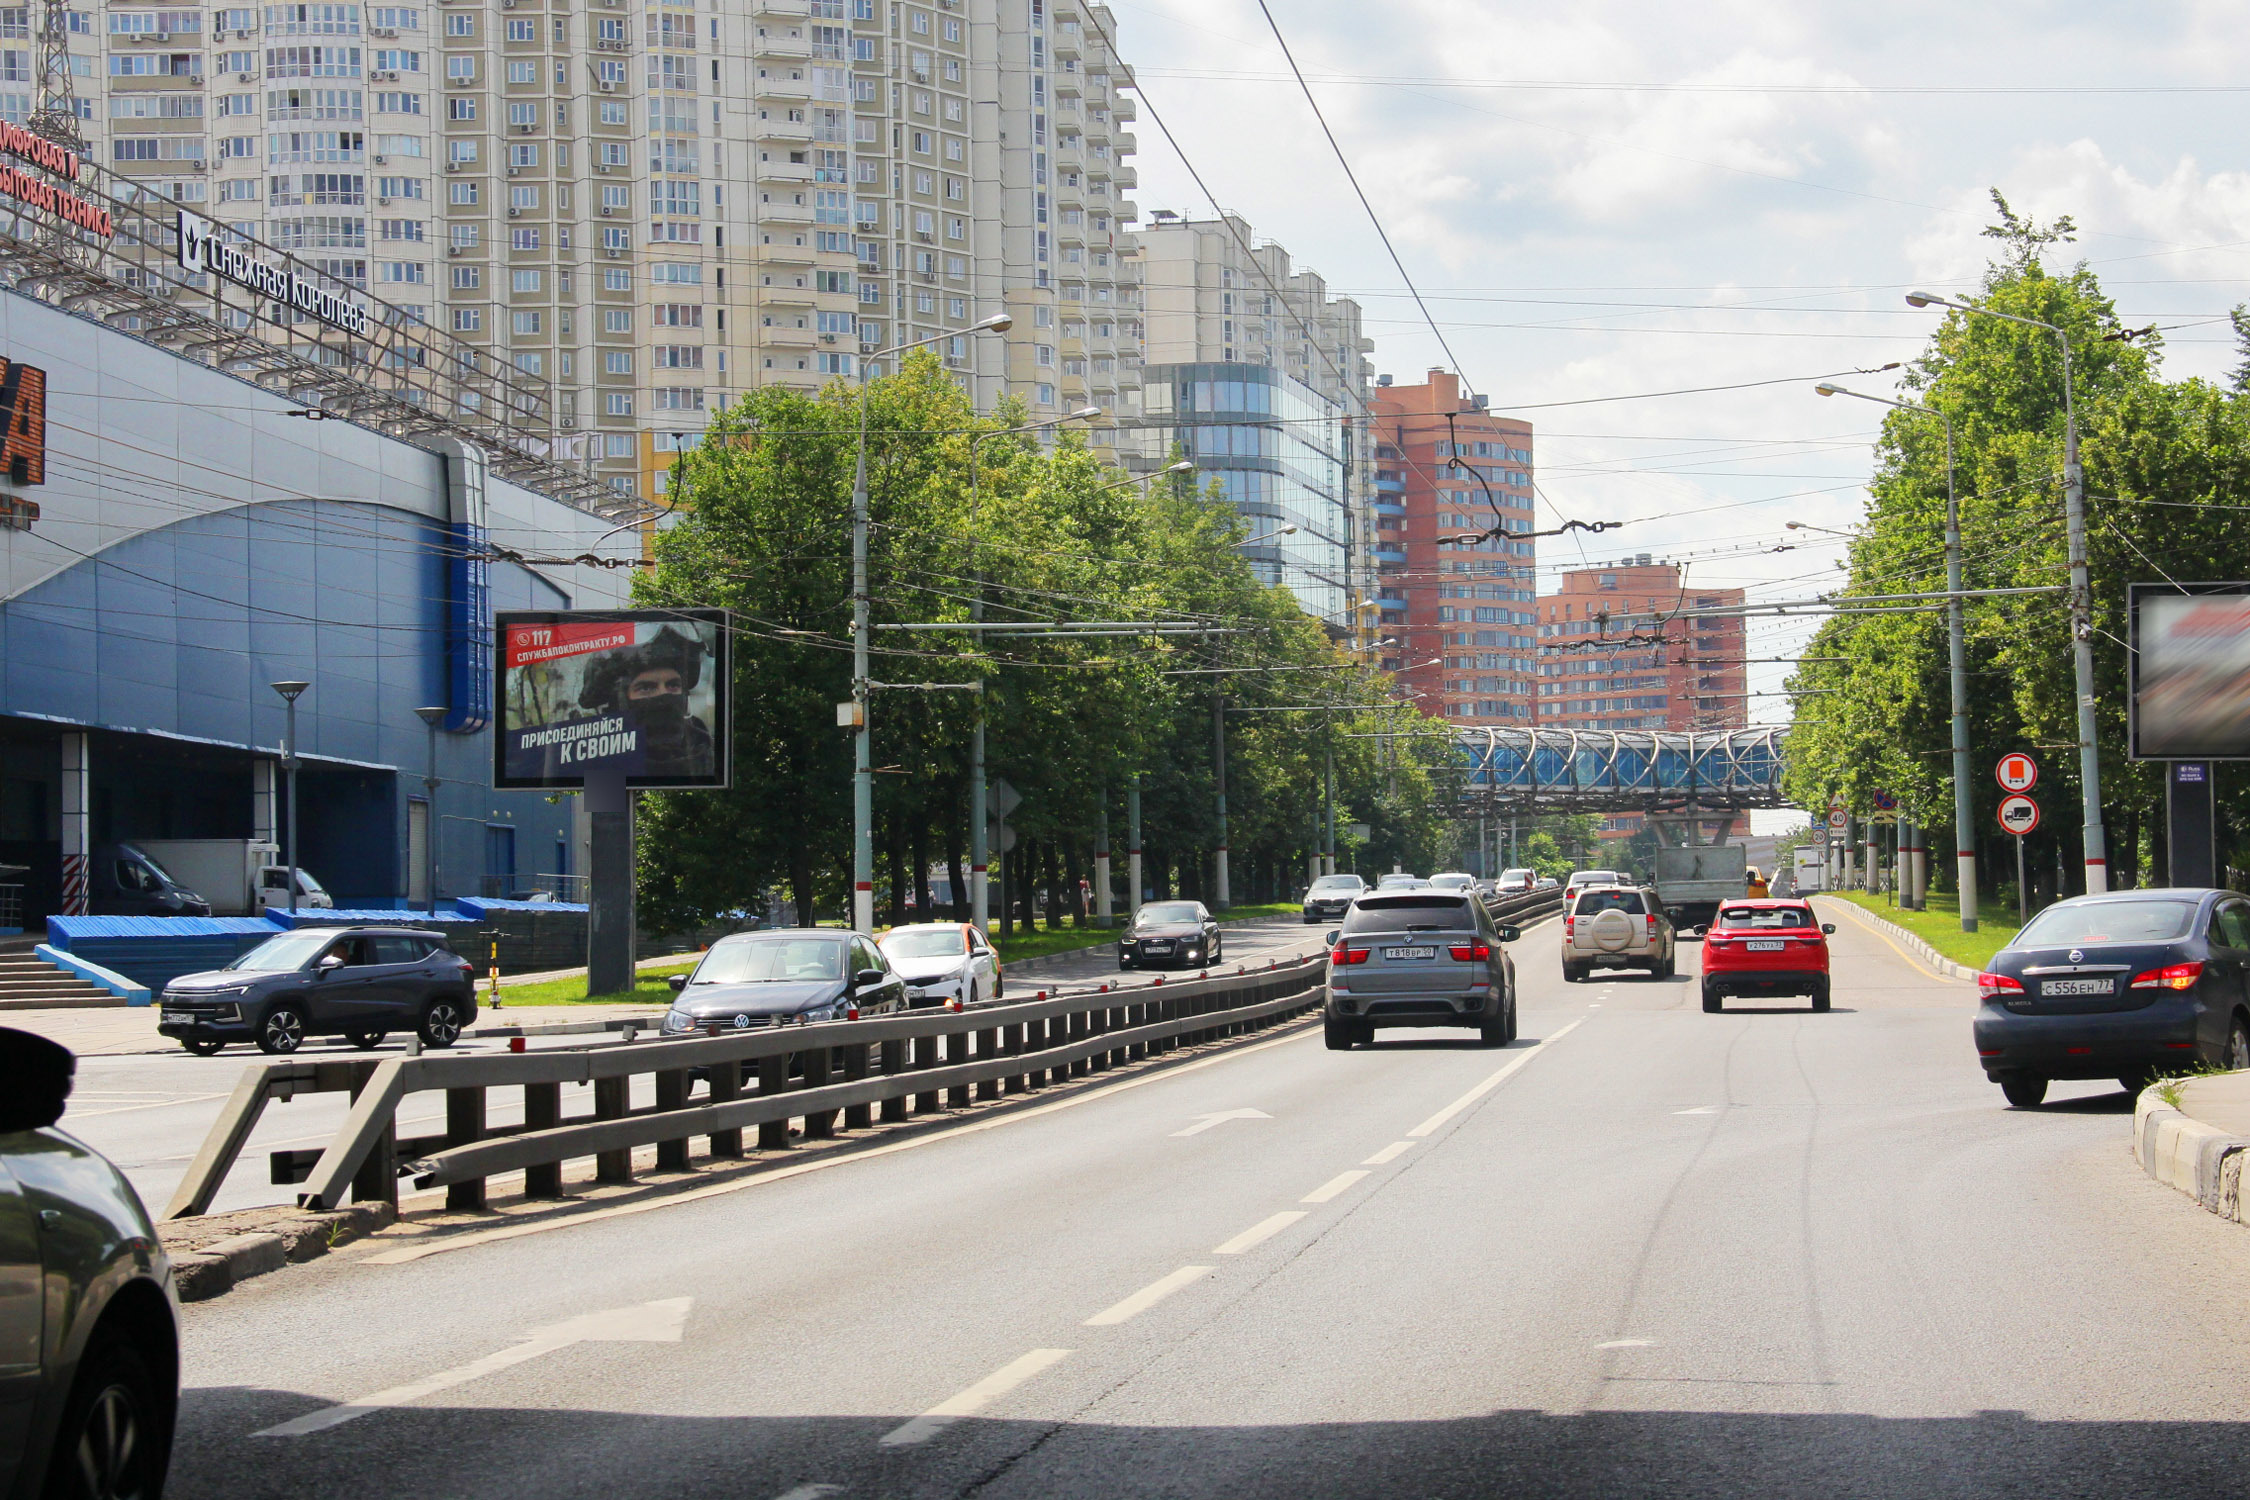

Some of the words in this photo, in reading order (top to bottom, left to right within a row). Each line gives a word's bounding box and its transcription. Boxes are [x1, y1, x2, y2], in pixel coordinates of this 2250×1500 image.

[69, 151, 79, 181] И
[56, 187, 112, 239] ТЕХНИКА
[207, 235, 288, 302] Снежная
[290, 271, 367, 335] Королева
[516, 635, 626, 663] СЛУЖБАПОКОНТРАКТУ.РФ
[531, 630, 552, 646] 117
[521, 717, 624, 750] ПРИСОЕДИНЯЙСЯ
[560, 742, 572, 765] К
[576, 730, 636, 762] СВОИМ
[1832, 814, 1844, 822] 40
